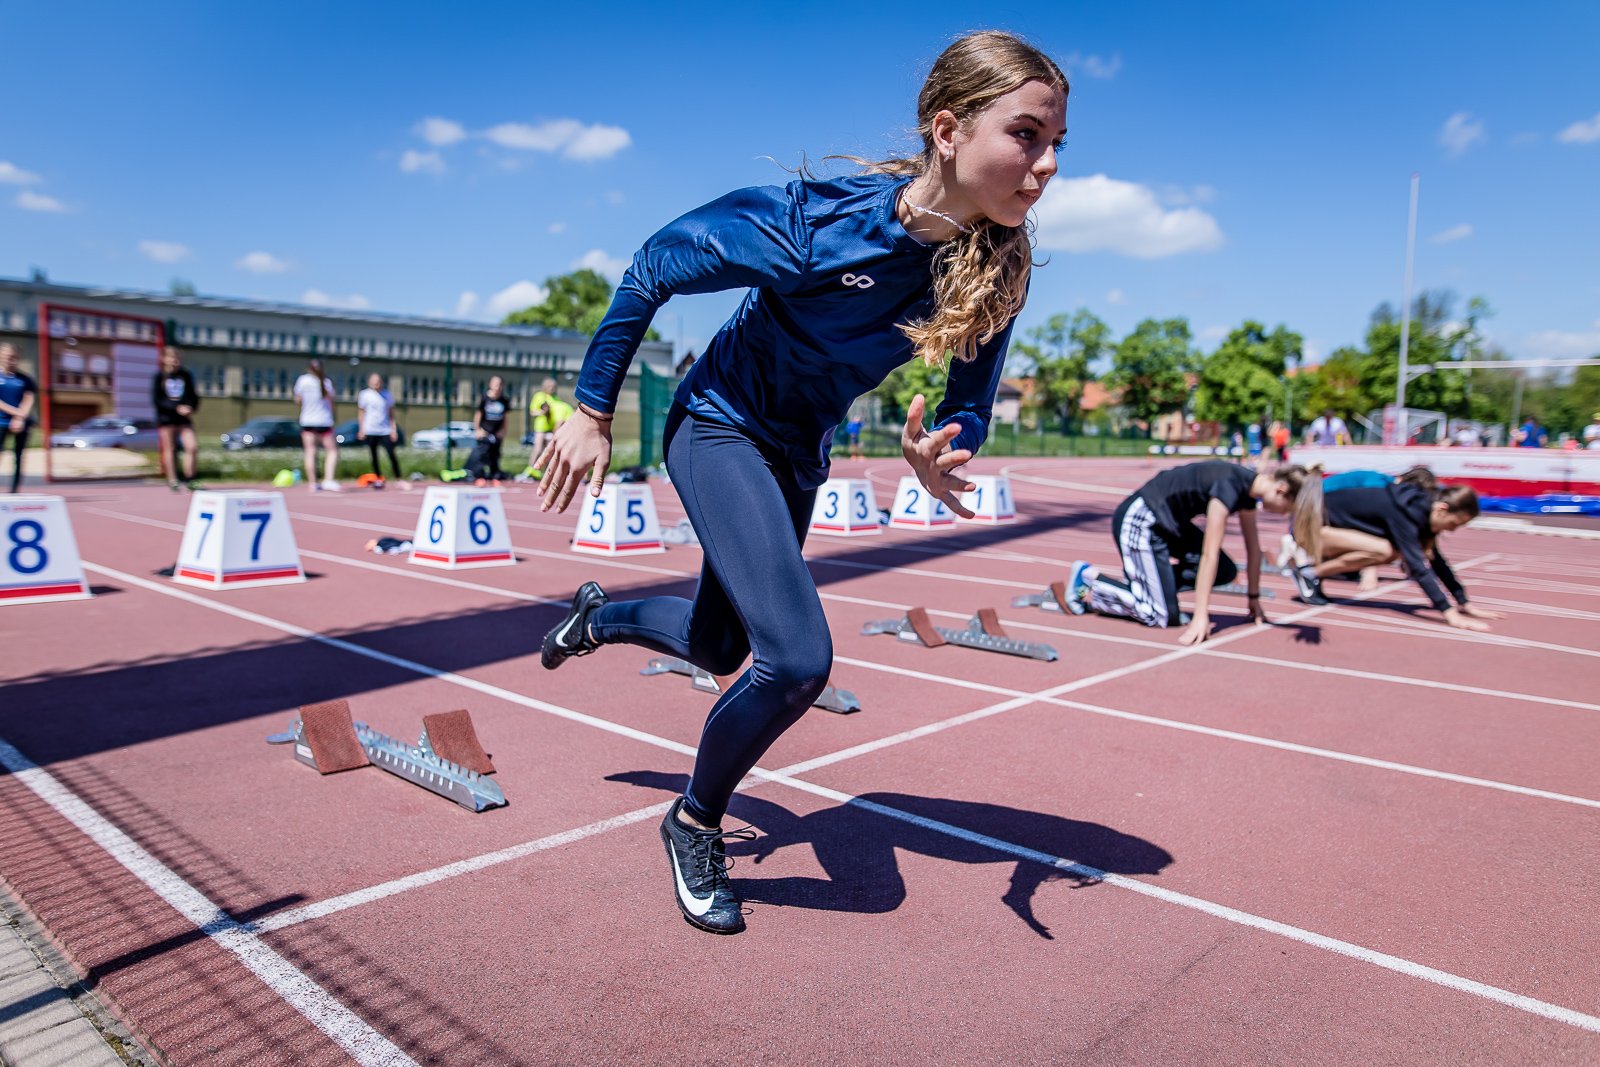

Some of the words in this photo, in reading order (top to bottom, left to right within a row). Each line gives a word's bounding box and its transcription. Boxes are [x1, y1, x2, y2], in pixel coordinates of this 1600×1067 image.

[824, 491, 839, 519] 3
[855, 491, 869, 520] 3
[905, 489, 919, 514] 2
[974, 487, 982, 510] 1
[999, 488, 1007, 510] 1
[429, 504, 446, 544] 6
[468, 505, 492, 545] 6
[590, 499, 605, 534] 5
[627, 499, 645, 535] 5
[7, 519, 49, 574] 8
[196, 512, 214, 560] 7
[239, 512, 271, 561] 7
